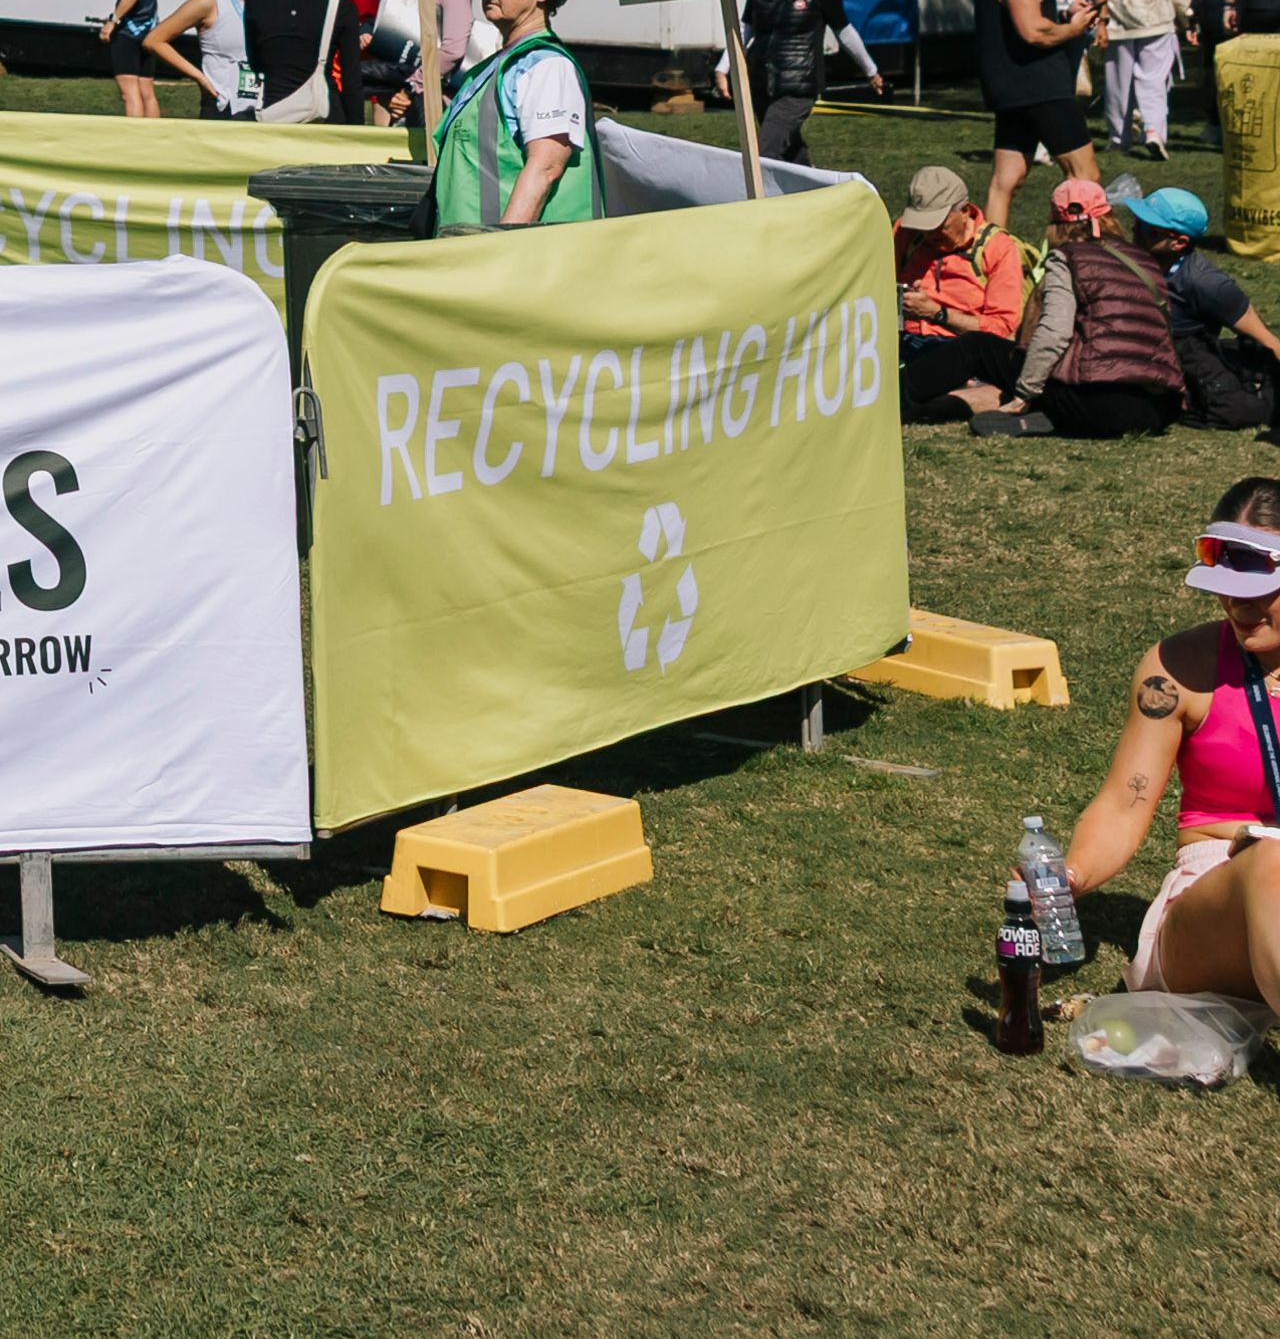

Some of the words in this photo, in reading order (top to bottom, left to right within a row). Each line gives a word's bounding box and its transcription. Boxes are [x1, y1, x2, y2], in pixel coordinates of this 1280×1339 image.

[376, 324, 767, 506] RECYCLING
[770, 296, 881, 427] HUB
[998, 927, 1040, 943] POWER
[1015, 943, 1040, 957] ADE
